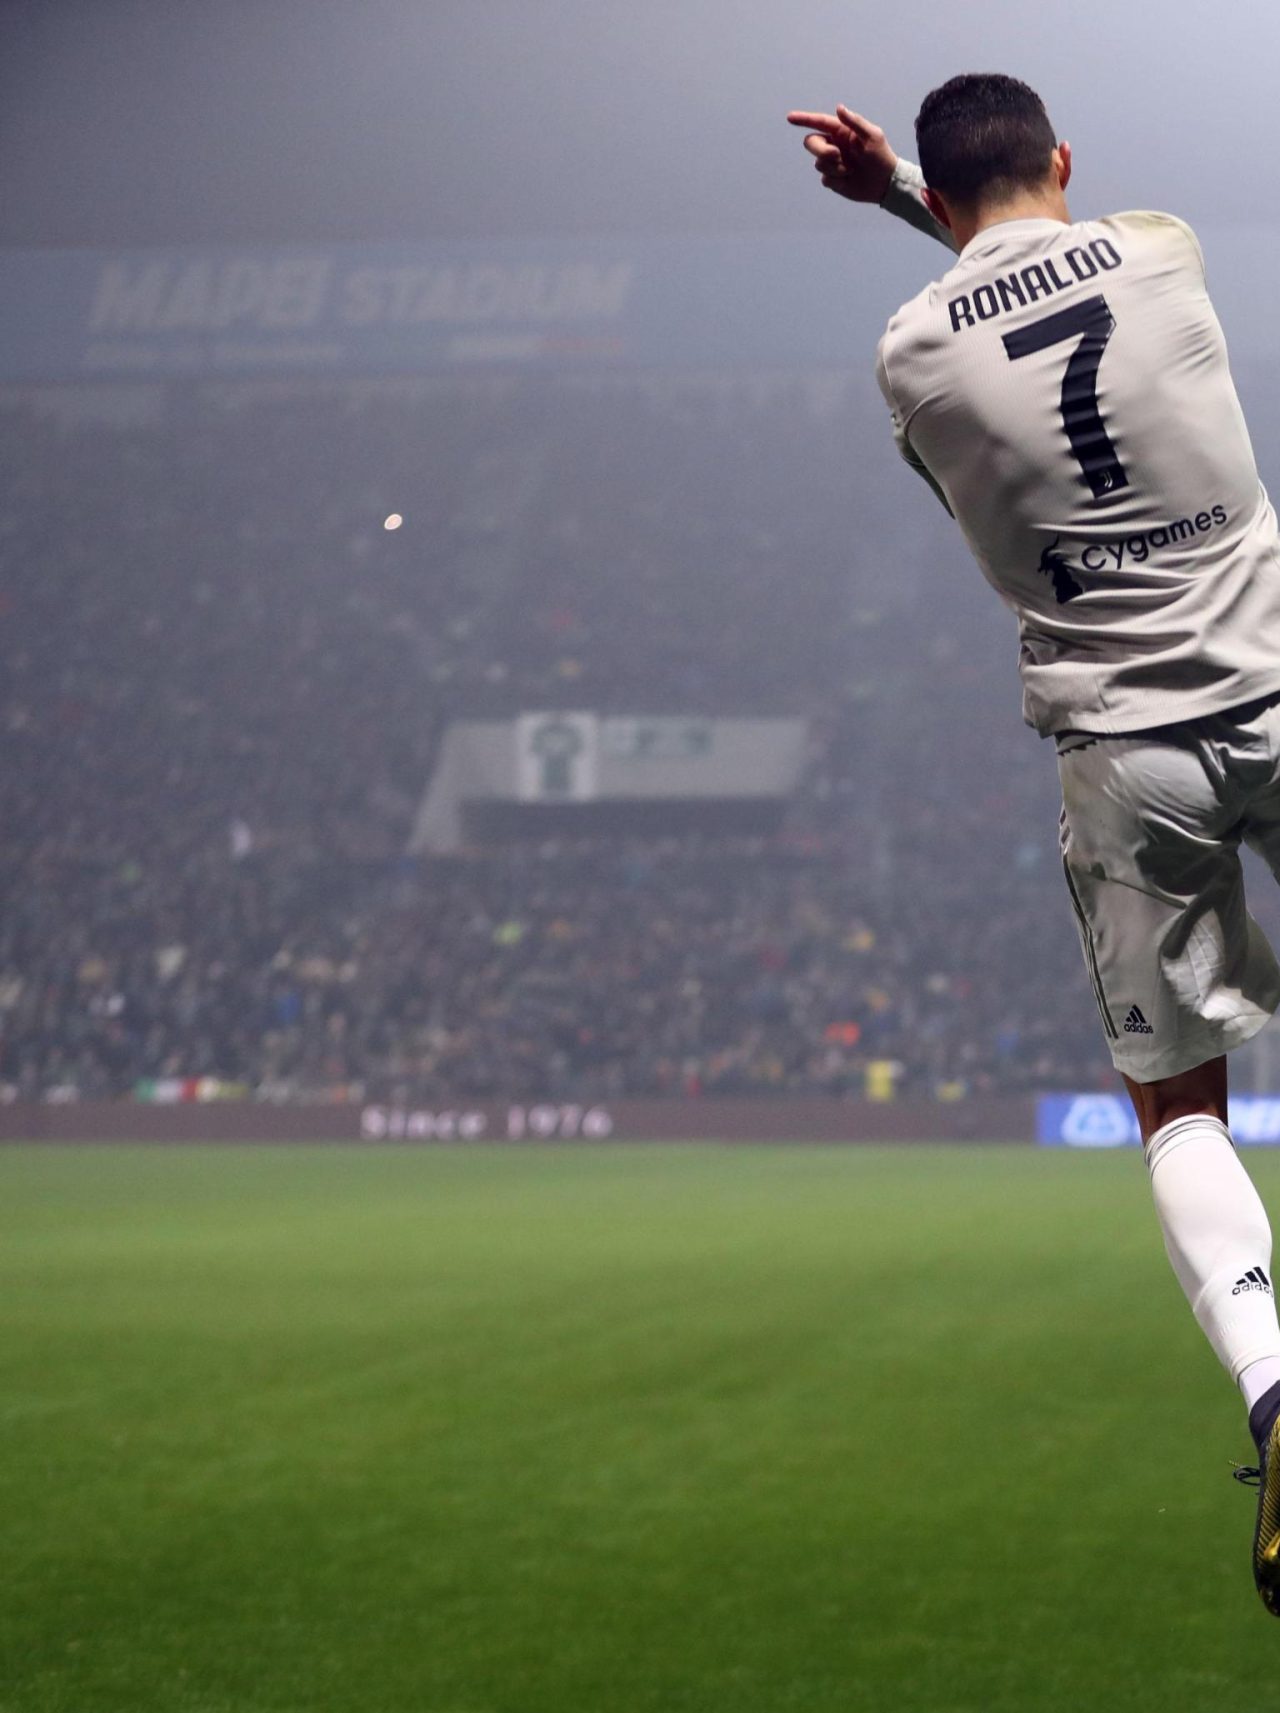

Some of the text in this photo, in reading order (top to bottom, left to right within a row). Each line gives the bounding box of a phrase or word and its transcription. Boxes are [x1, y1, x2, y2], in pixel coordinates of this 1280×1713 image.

[948, 238, 1123, 333] RONALDO
[1001, 294, 1129, 499] 7
[1081, 504, 1228, 571] Cygames
[1123, 1023, 1154, 1034] adidas
